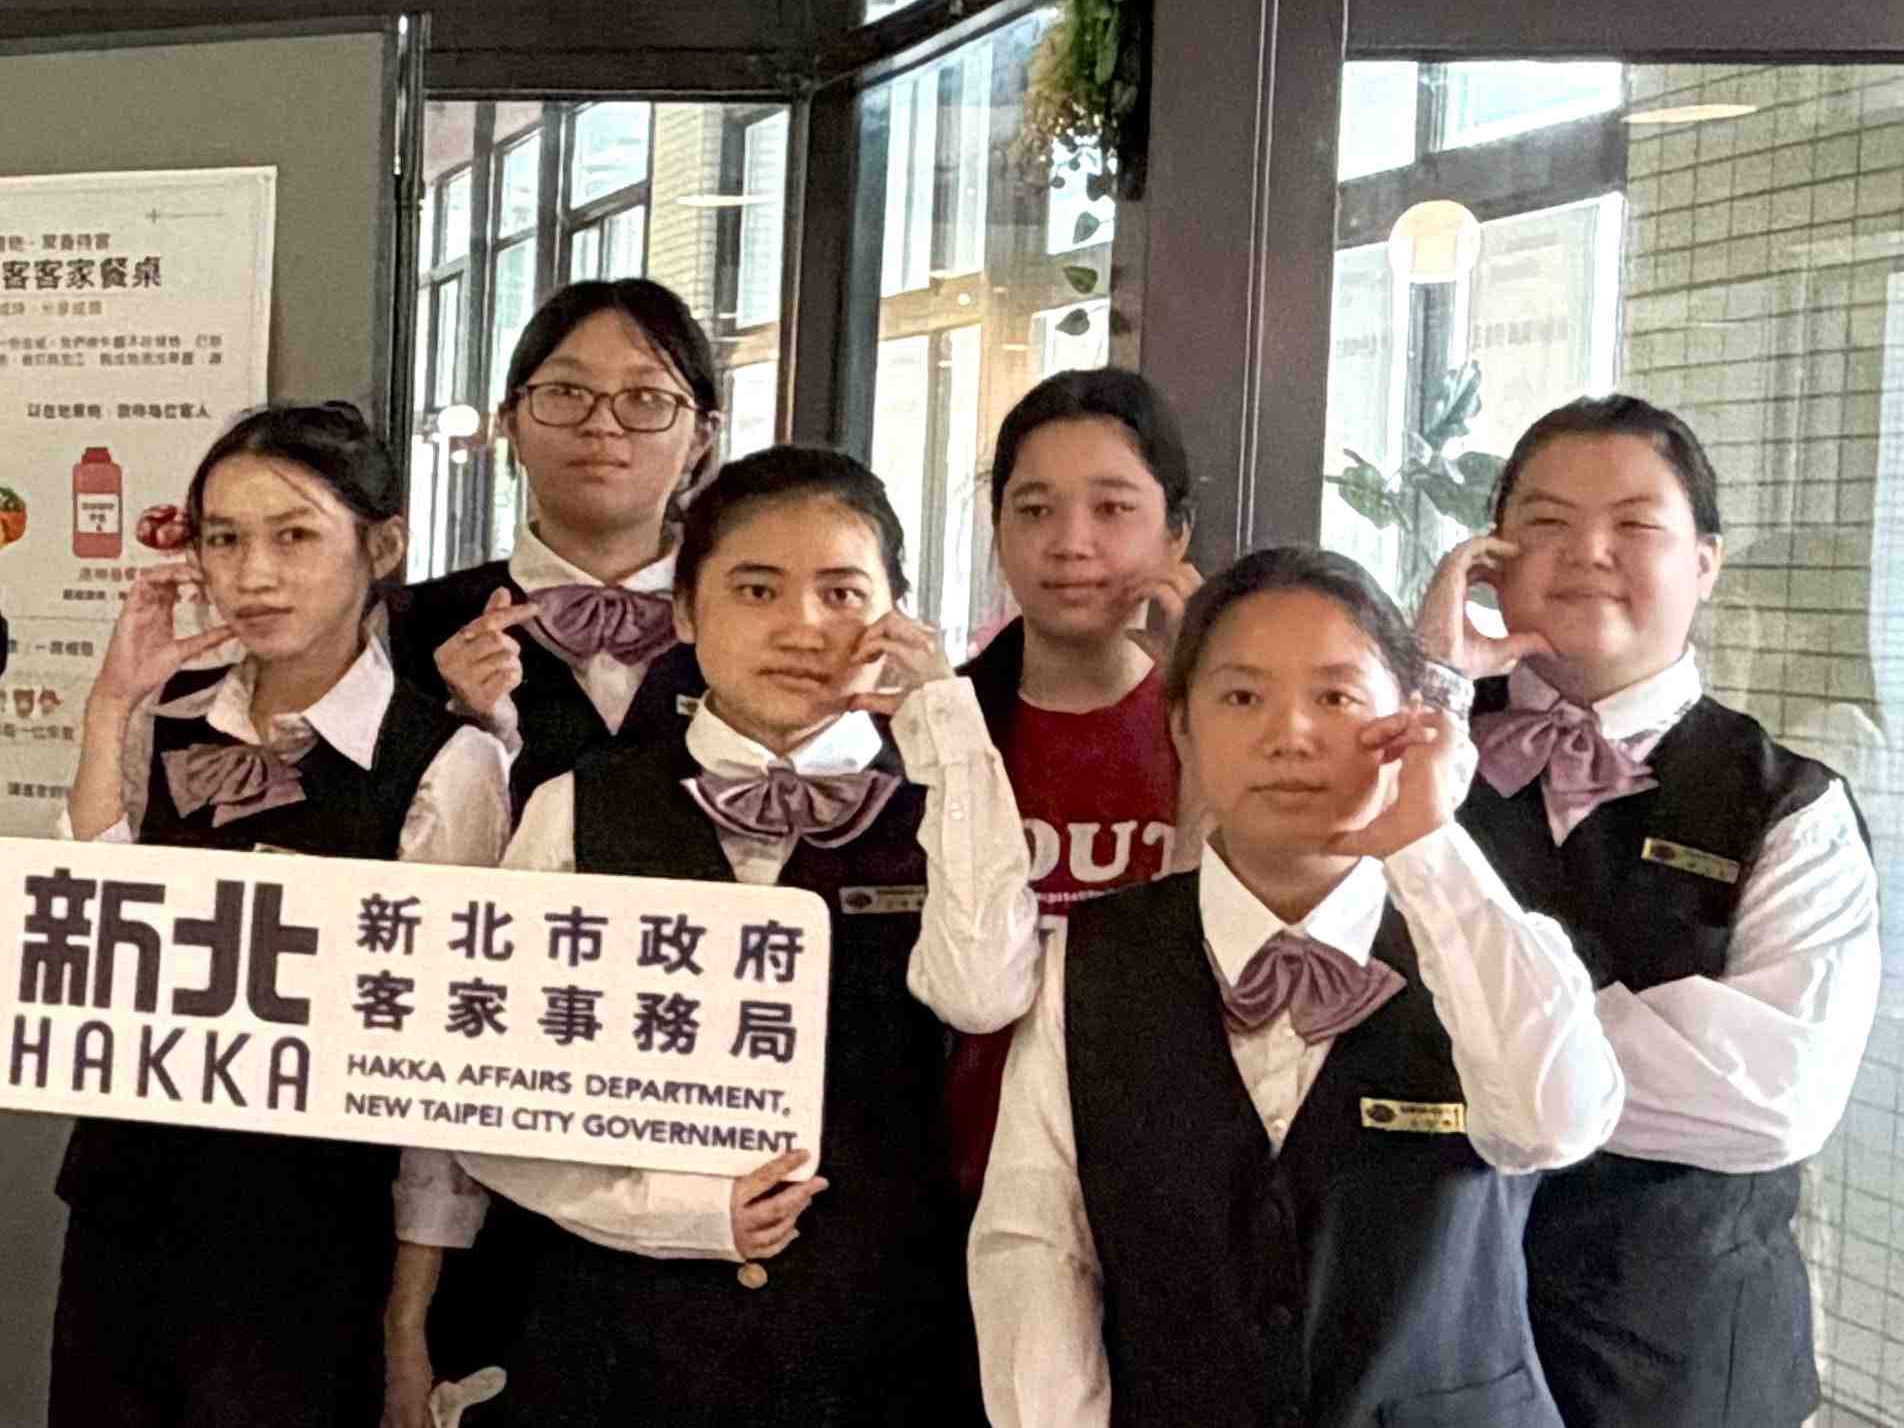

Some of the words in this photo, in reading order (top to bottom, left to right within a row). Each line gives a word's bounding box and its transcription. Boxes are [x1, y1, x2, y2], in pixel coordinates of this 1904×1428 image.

[19, 868, 319, 1026] 新北
[356, 892, 805, 984] 新北市政府
[9, 1014, 310, 1112] HAKKA
[352, 970, 798, 1064] 客家事務局
[346, 1052, 446, 1083] HAKKA
[457, 1063, 573, 1094] AFFAIRS
[344, 1092, 412, 1118] NEW
[418, 1098, 504, 1128] TAIPEI
[512, 1106, 575, 1134] CITY
[582, 1113, 798, 1154] GOVERNMENT
